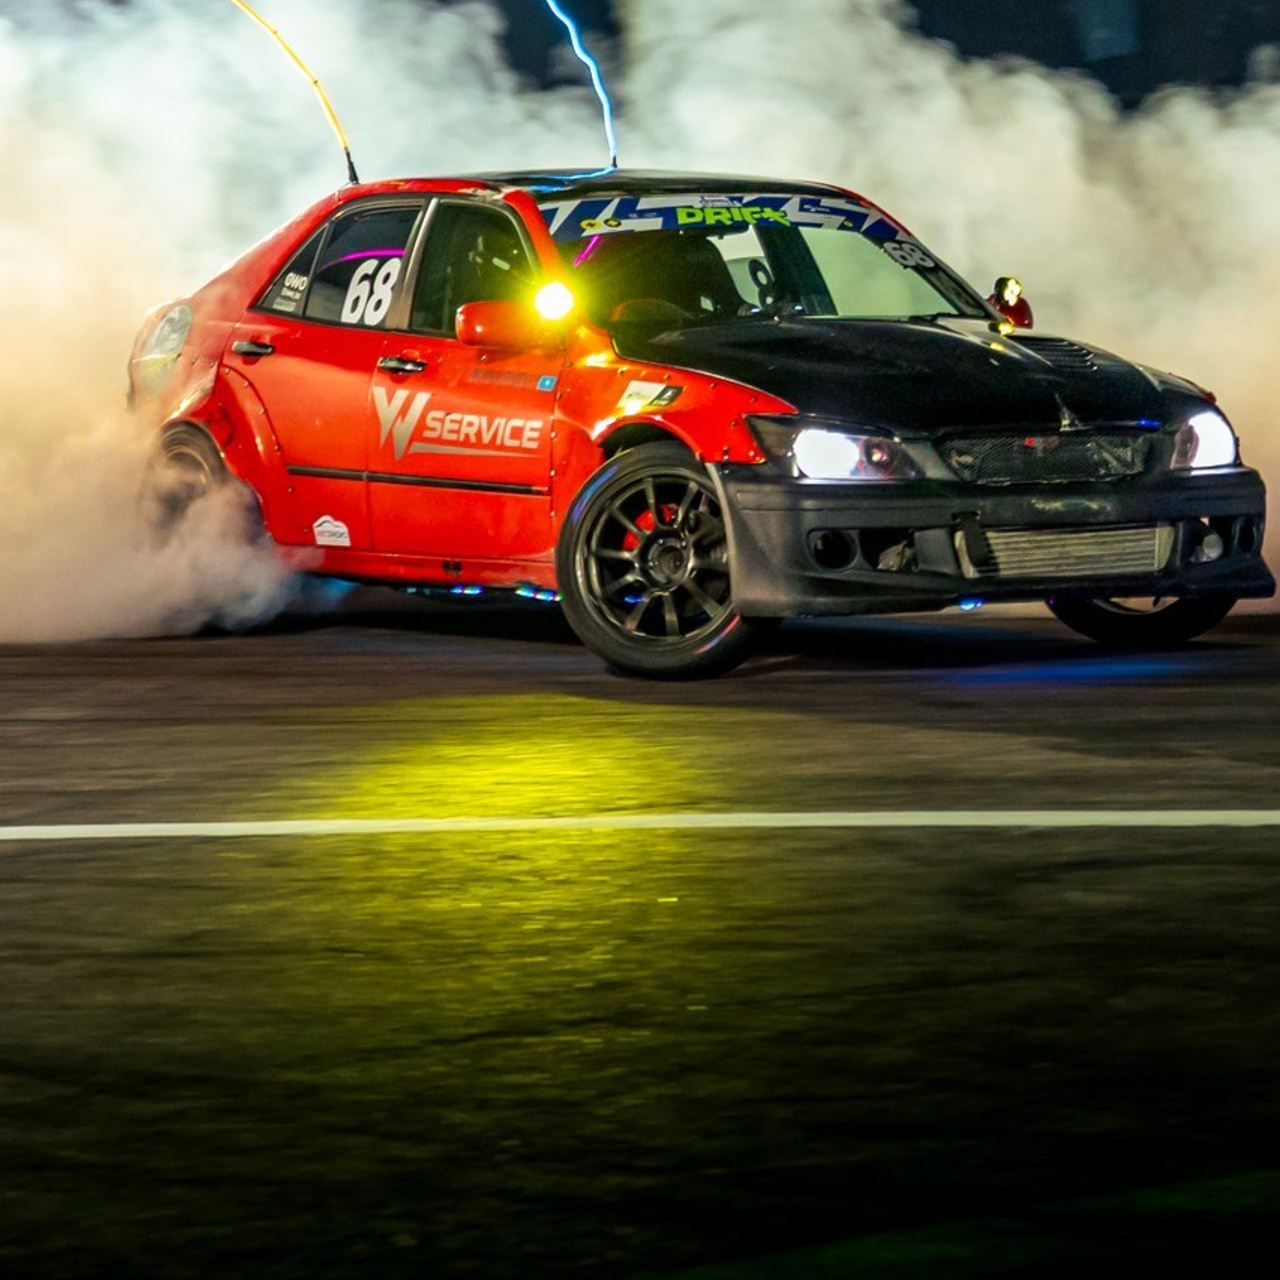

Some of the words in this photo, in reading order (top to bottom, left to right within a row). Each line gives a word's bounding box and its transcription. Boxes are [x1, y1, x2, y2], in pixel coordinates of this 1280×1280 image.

[882, 241, 935, 267] 68
[341, 257, 401, 326] 68
[423, 410, 543, 449] SERVICE
